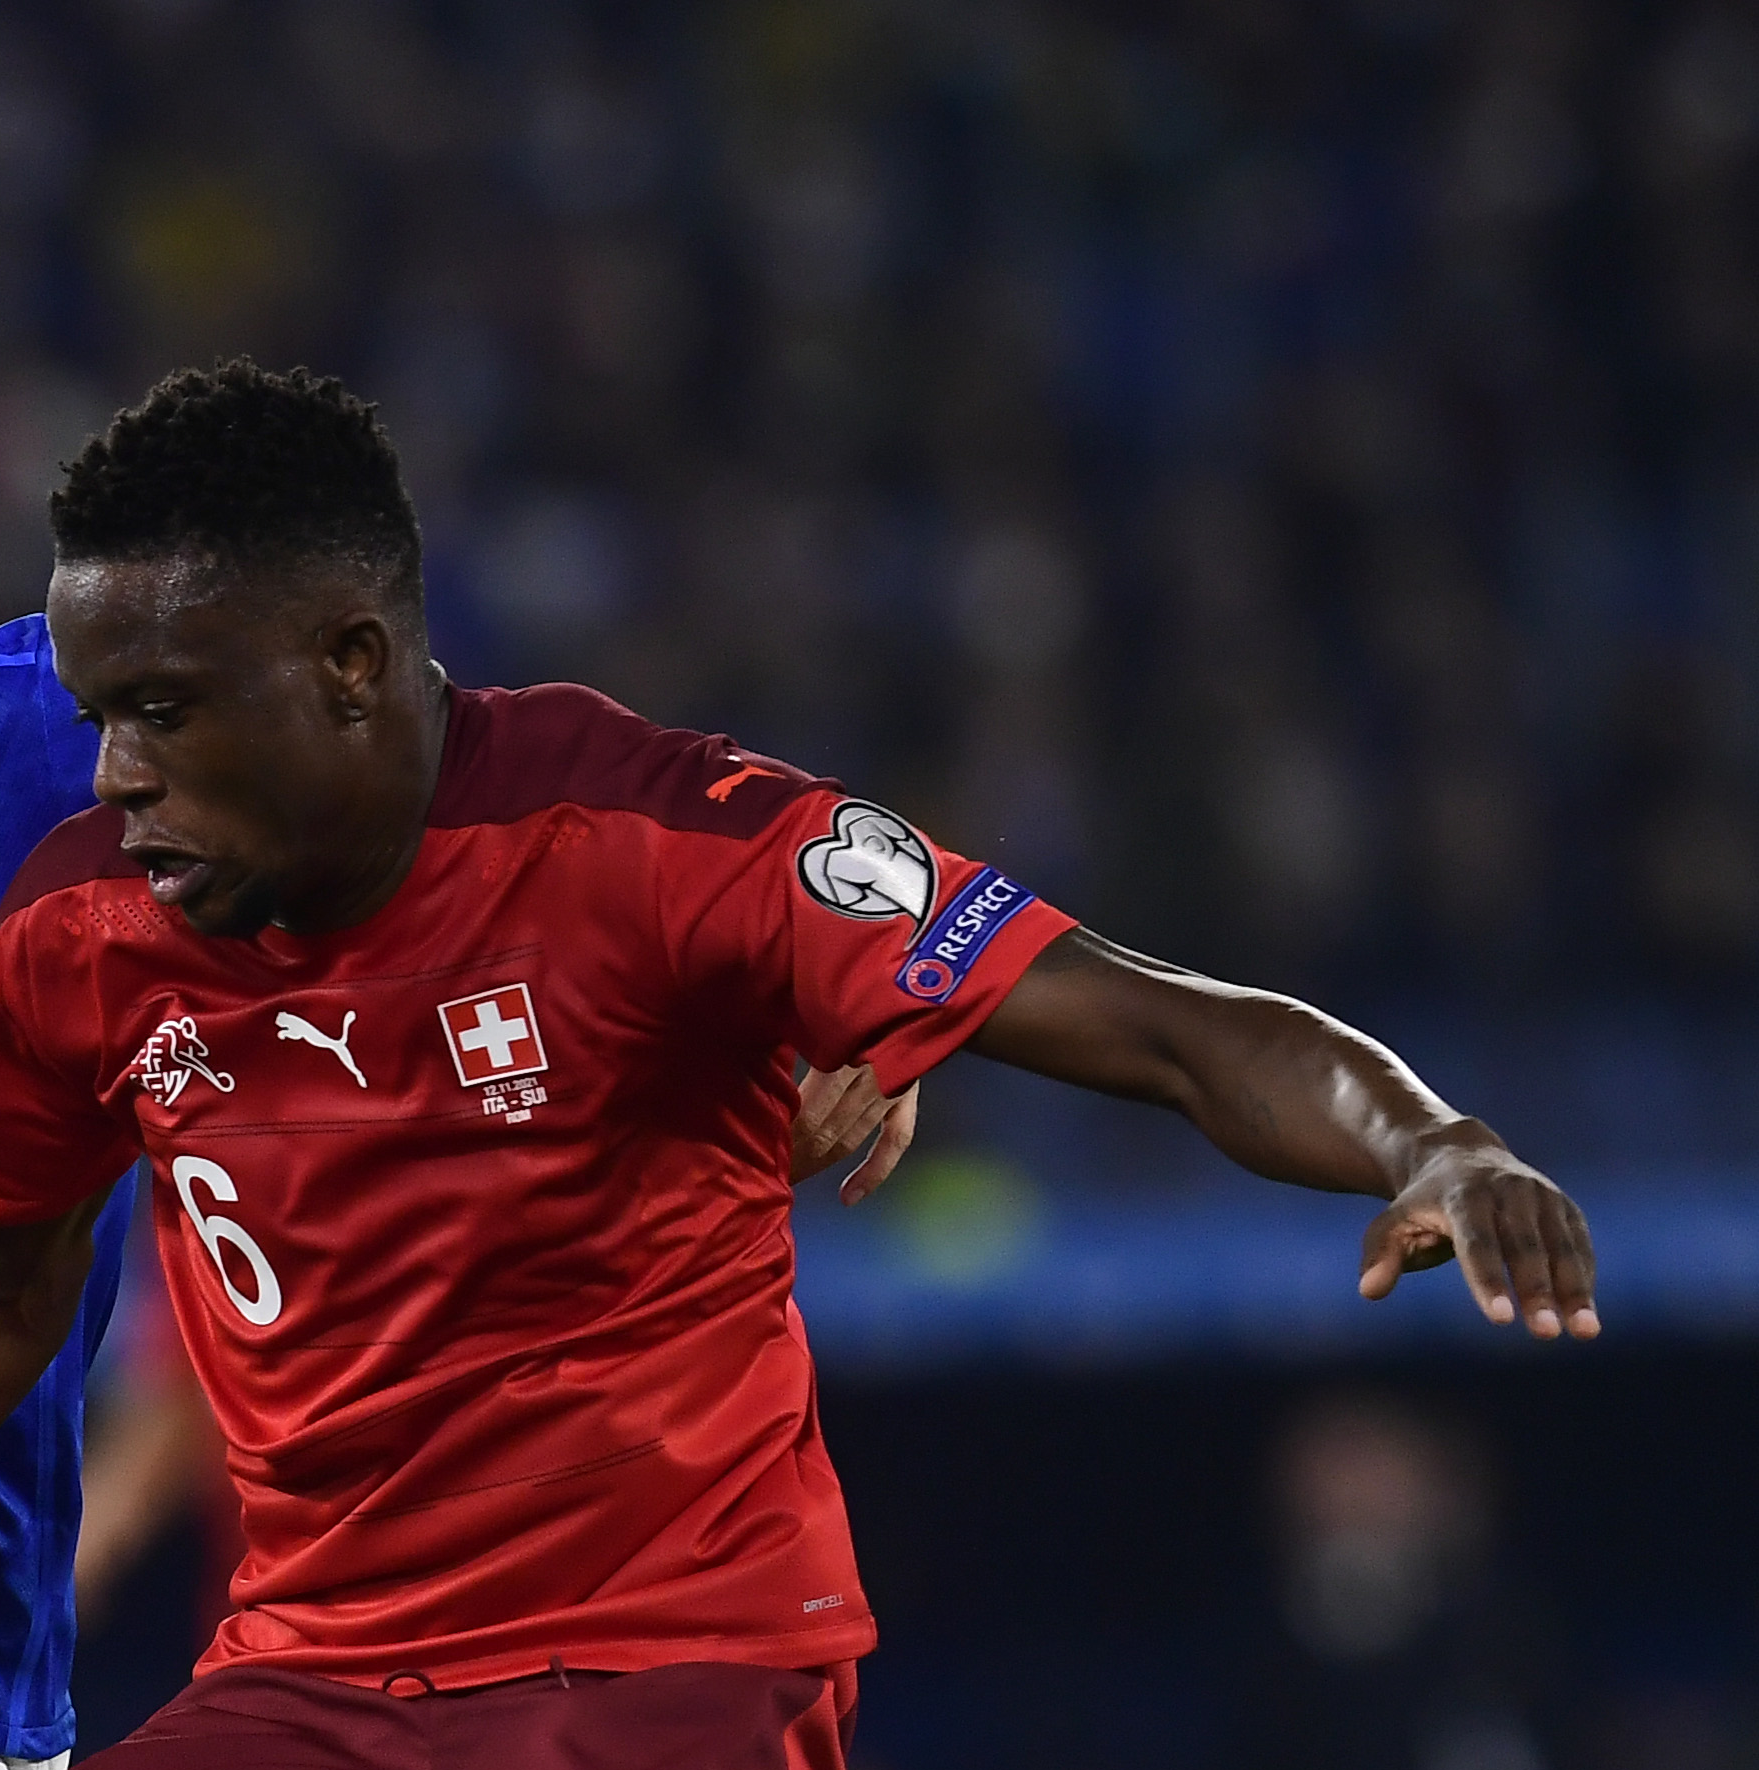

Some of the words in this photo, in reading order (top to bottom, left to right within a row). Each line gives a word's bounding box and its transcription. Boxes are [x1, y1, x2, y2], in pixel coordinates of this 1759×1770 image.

[934, 876, 1019, 961] RESPECT
[482, 1096, 510, 1115] ITA
[520, 1086, 548, 1107] SUI
[172, 1155, 282, 1326] 6
